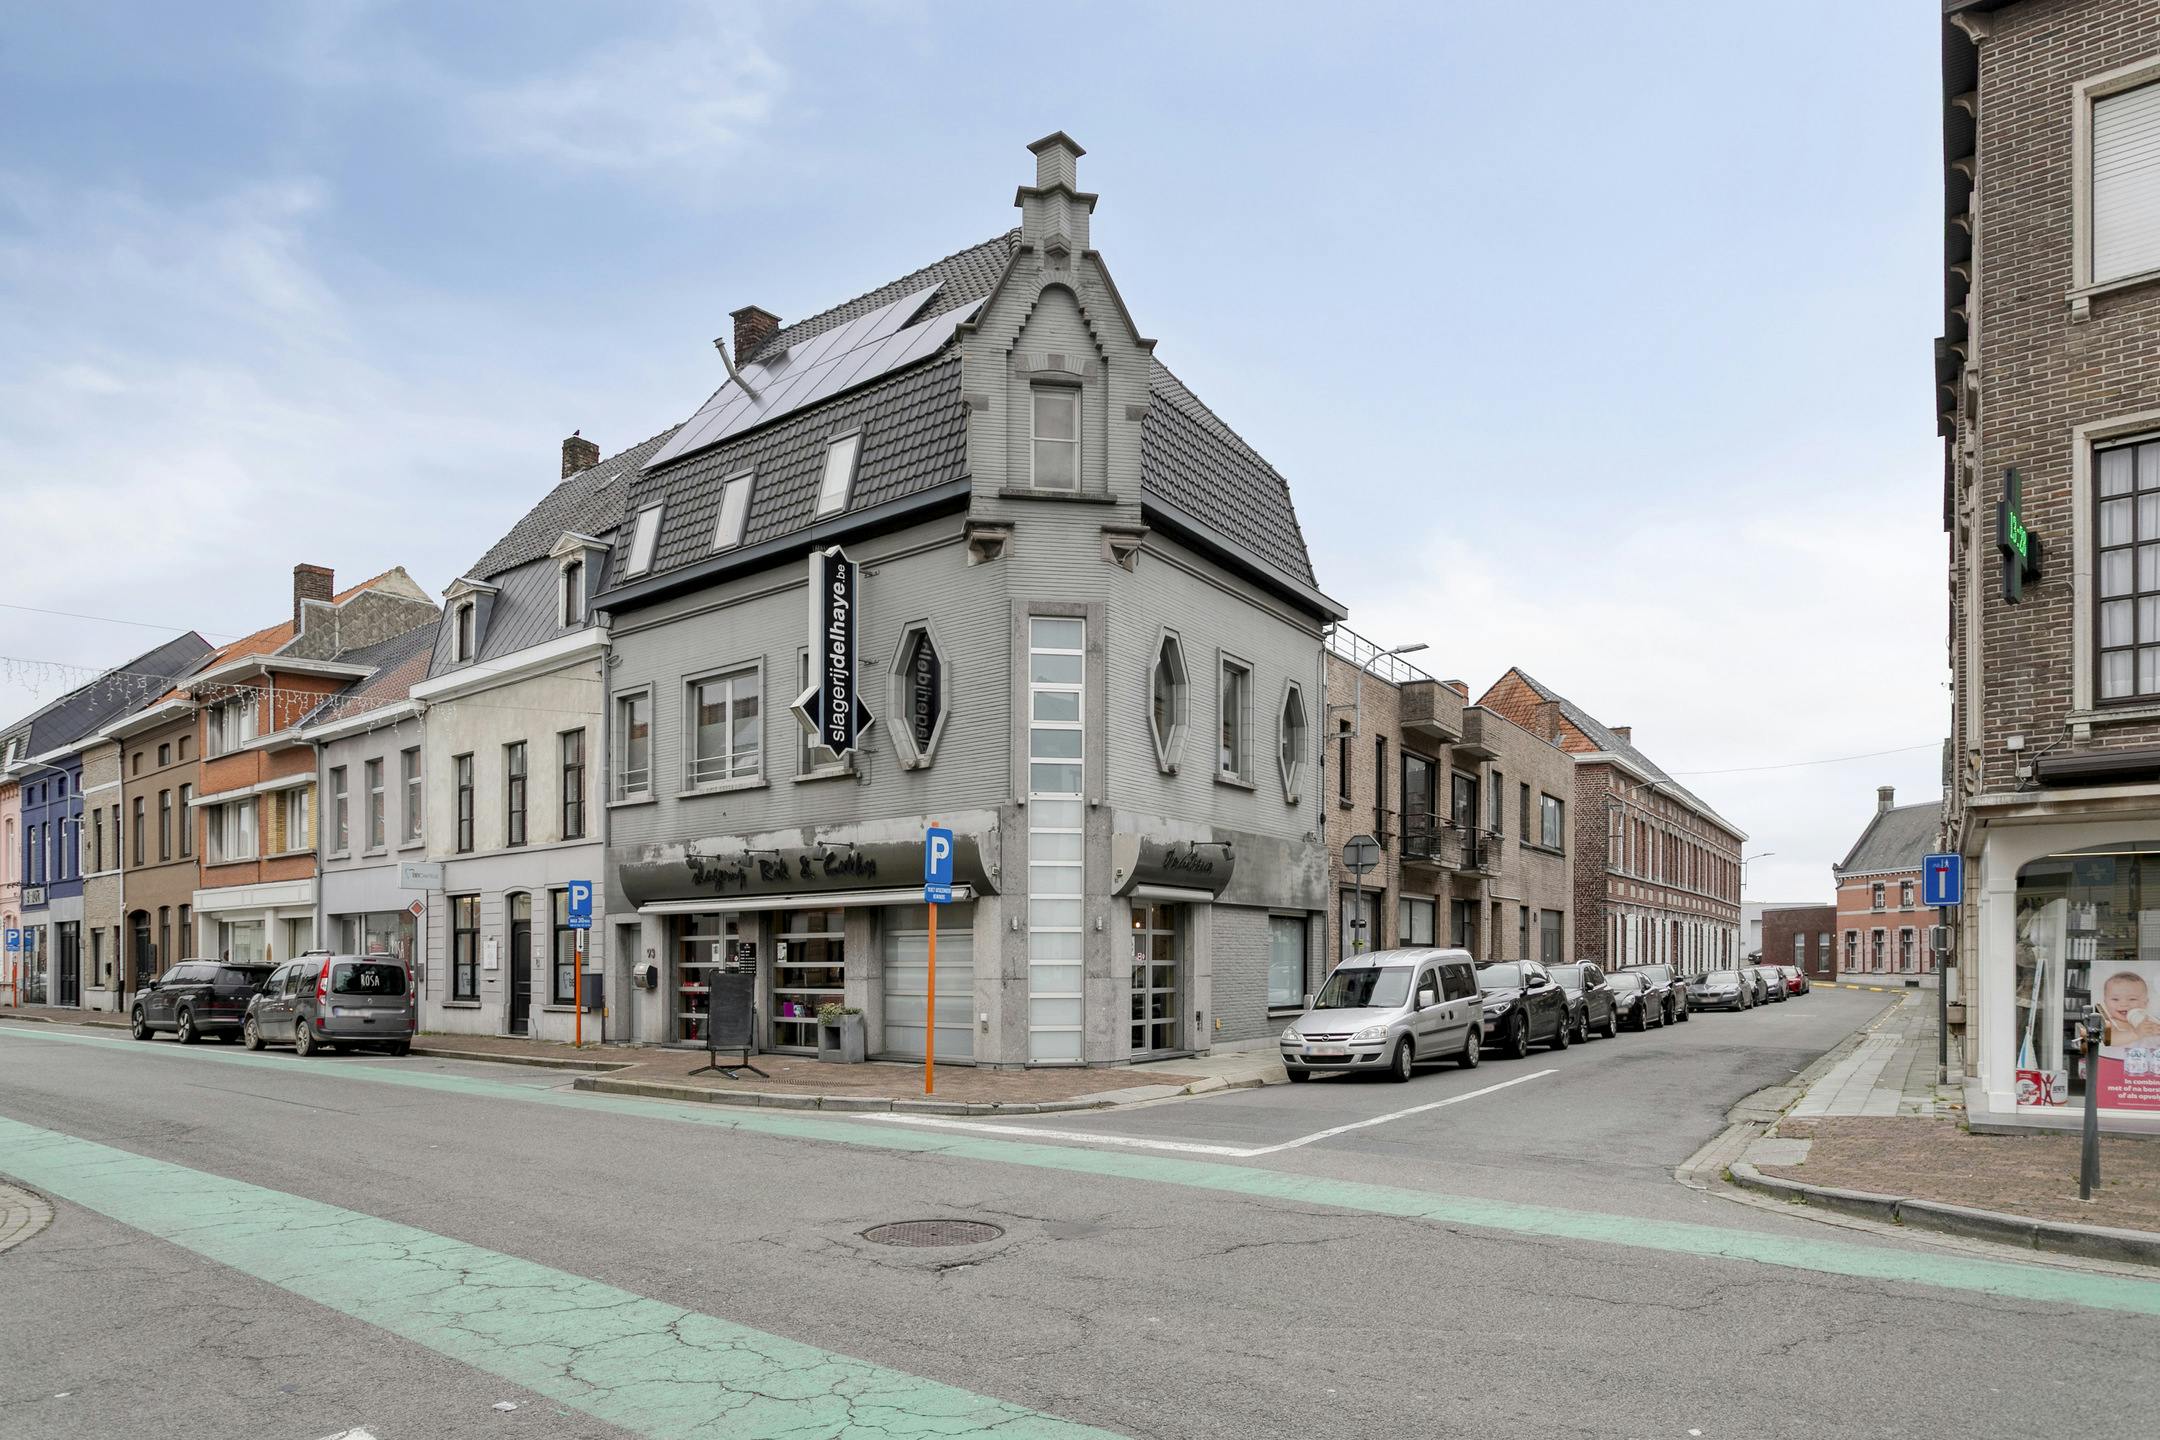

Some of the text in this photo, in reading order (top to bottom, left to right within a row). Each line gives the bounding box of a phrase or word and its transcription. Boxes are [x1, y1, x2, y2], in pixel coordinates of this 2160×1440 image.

[829, 564, 849, 742] slagerijdelhaye.be
[758, 857, 791, 882] Rik
[799, 855, 817, 881] &
[931, 836, 950, 875] P
[572, 885, 589, 911] P
[8, 931, 18, 943] P
[360, 974, 380, 987] ROSA
